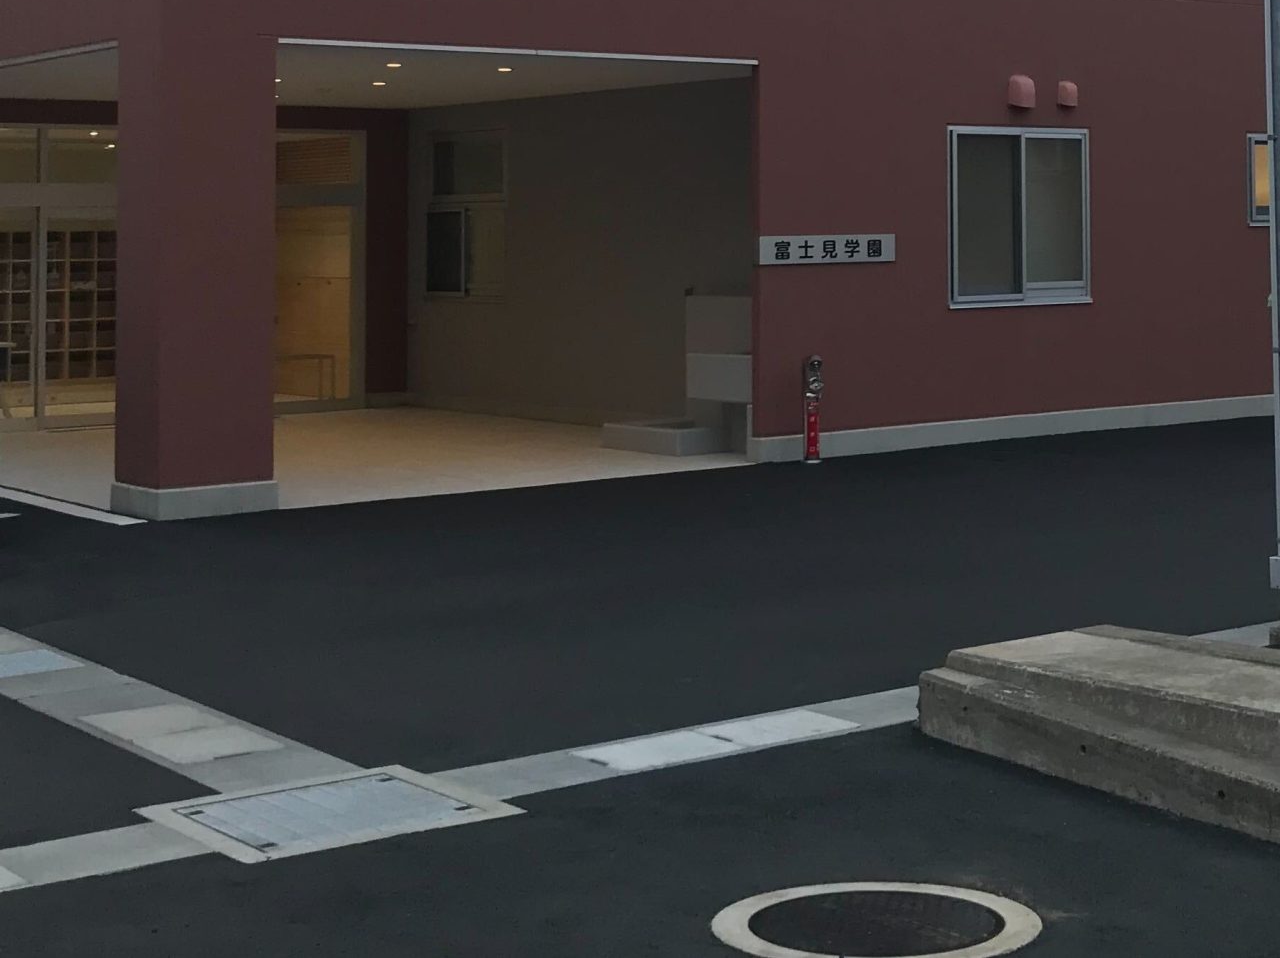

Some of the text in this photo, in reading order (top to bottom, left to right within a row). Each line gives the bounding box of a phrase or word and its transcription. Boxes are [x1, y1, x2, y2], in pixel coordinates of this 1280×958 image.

[774, 239, 882, 260] 富士見学園
